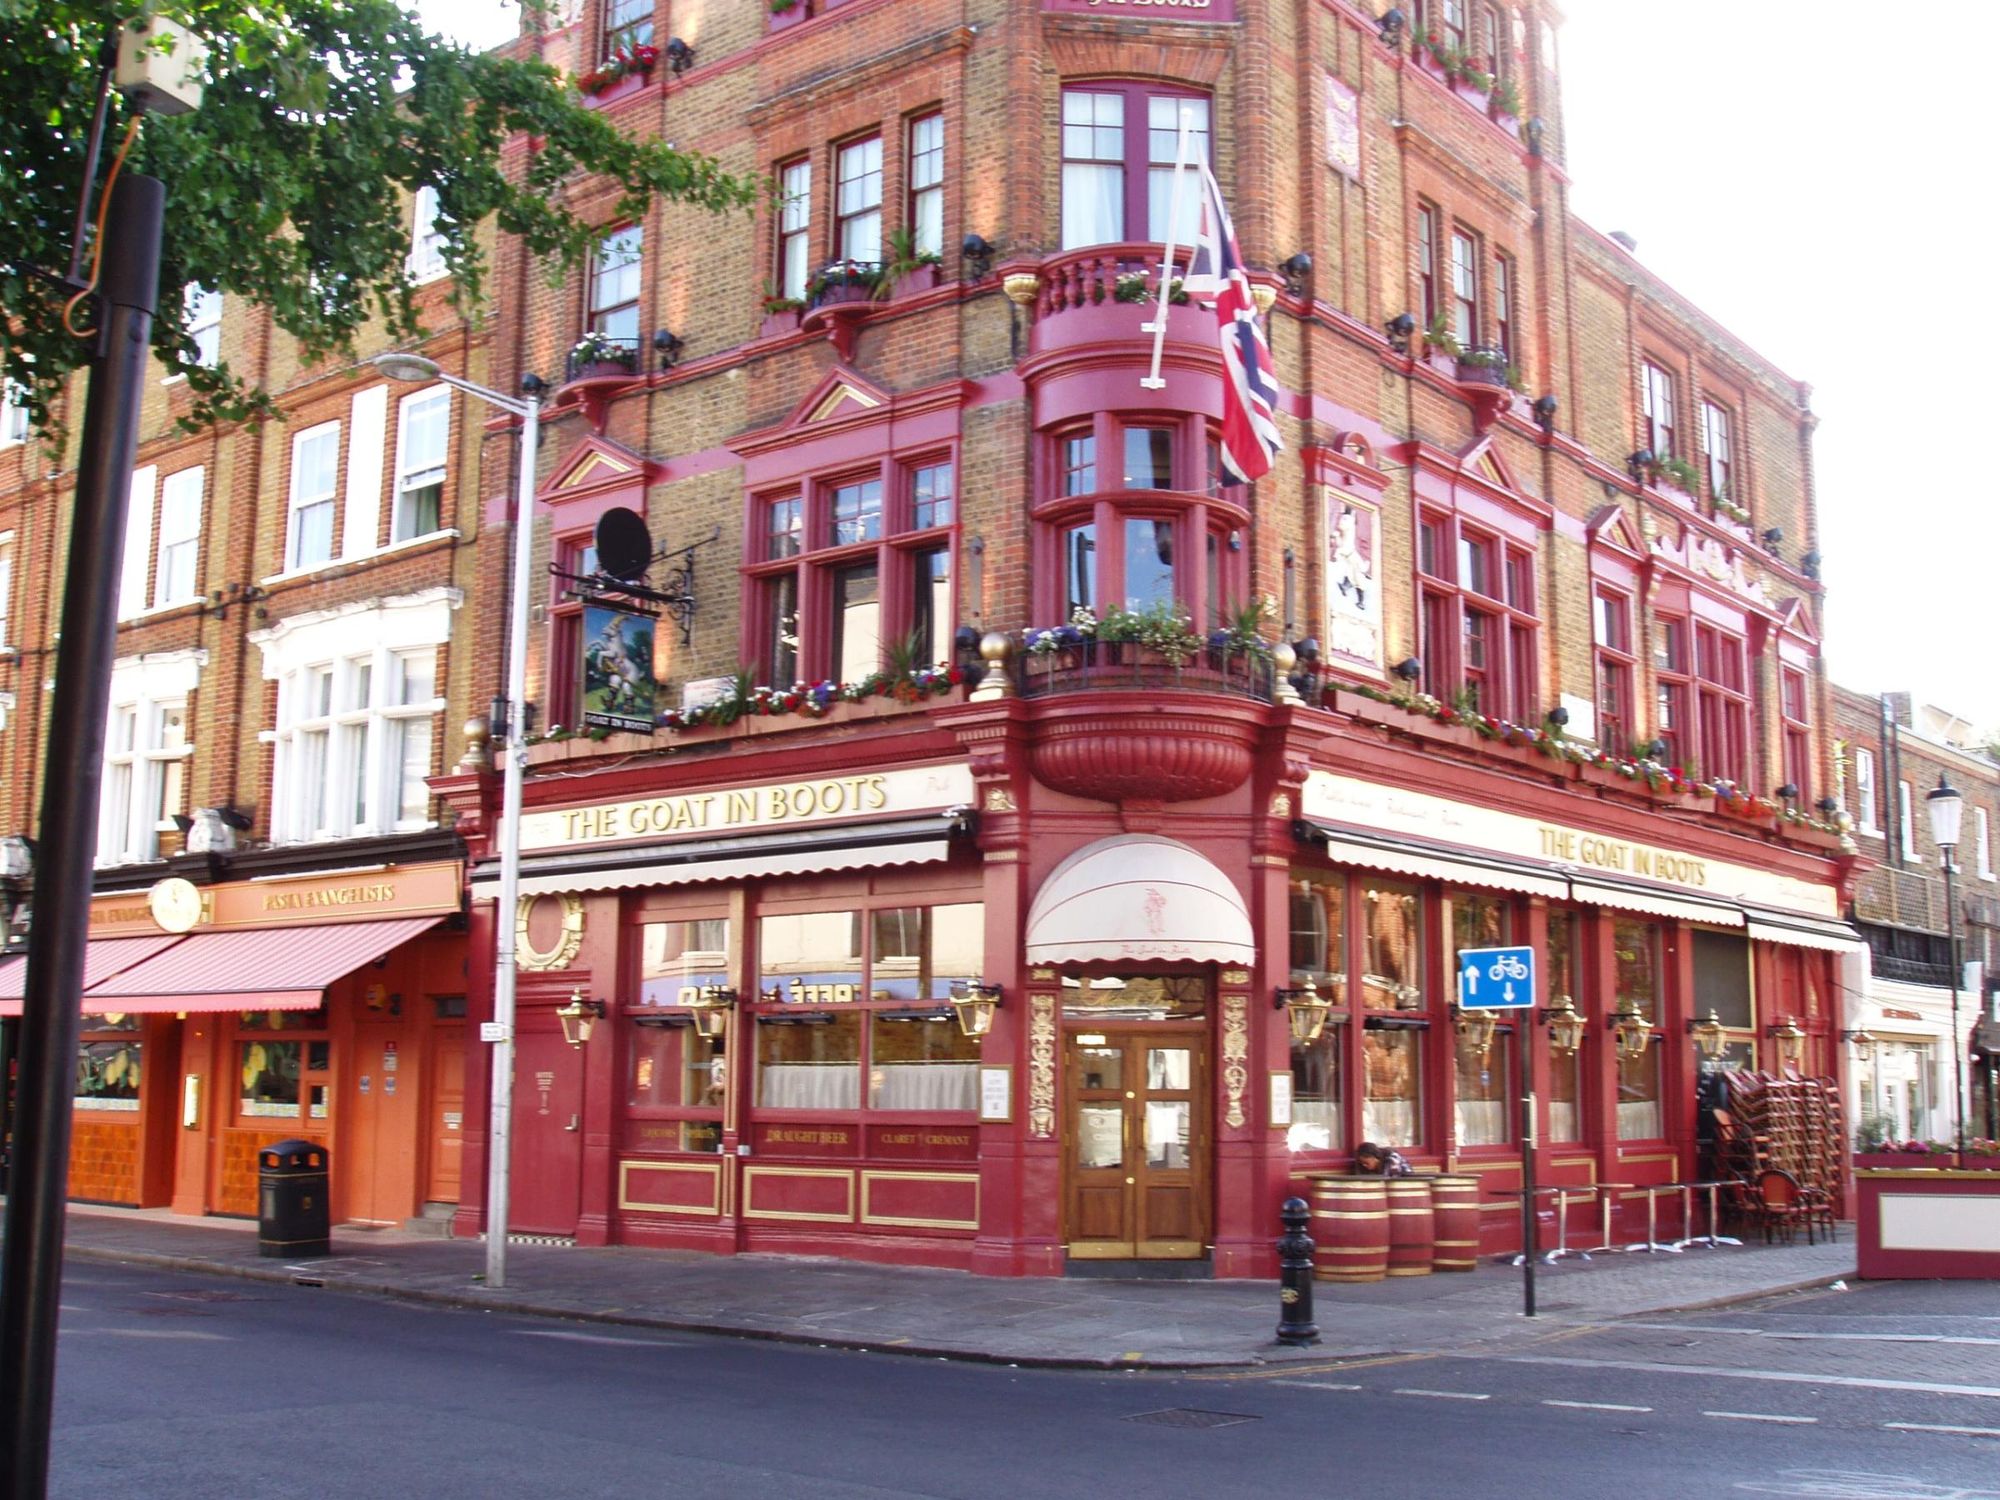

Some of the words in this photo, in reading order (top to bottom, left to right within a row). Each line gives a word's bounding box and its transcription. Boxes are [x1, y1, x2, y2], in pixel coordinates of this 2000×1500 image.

[561, 807, 617, 840] THE
[627, 796, 714, 834] GOAT
[724, 791, 758, 823] IN
[768, 776, 886, 820] BOOTS
[1538, 827, 1575, 860] THE
[1581, 837, 1628, 870] GOAT
[1633, 847, 1650, 875] IN
[1655, 854, 1706, 886] BOOTS
[263, 893, 302, 911] PASTA
[304, 884, 396, 907] EVANGELISTS
[766, 1130, 819, 1143] DRAUGHT
[820, 1131, 849, 1144] BEER
[881, 1133, 915, 1144] CLARET
